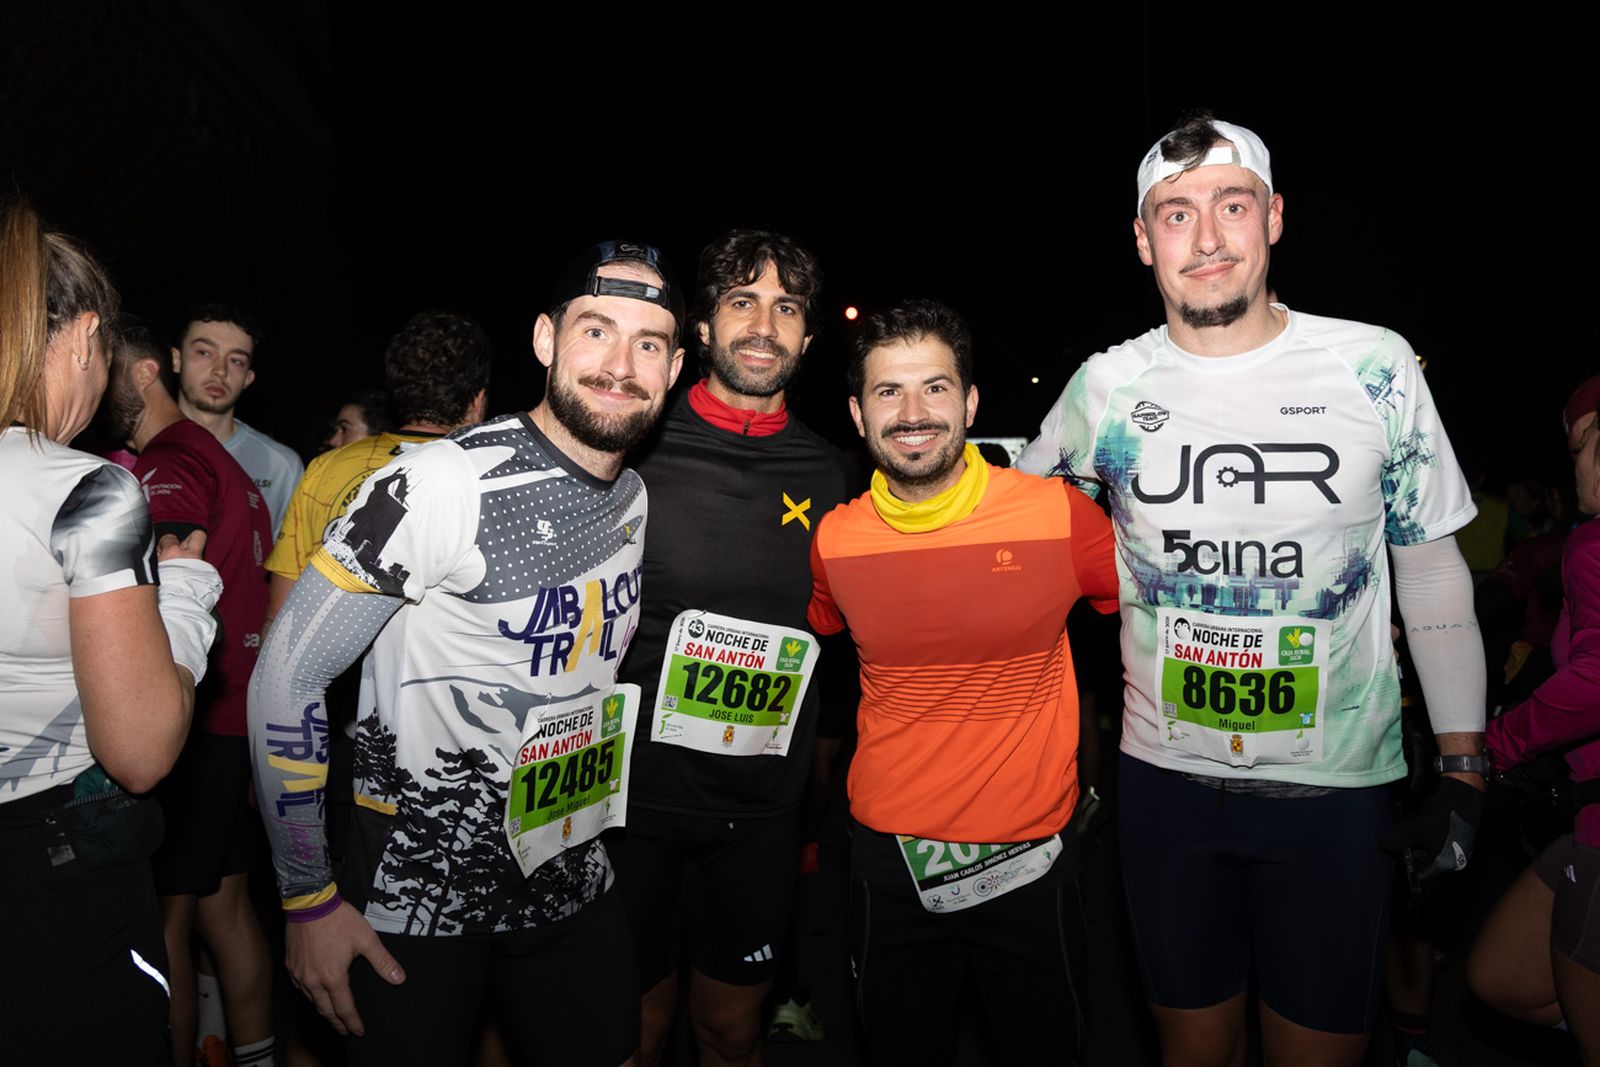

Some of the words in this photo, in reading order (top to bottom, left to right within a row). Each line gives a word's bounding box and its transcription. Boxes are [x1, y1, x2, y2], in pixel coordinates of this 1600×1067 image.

[1280, 406, 1327, 415] GSPORT
[1131, 443, 1342, 504] JAR
[705, 629, 749, 649] NOCHE
[751, 637, 769, 652] DE
[1192, 629, 1240, 648] NOCHE
[1243, 634, 1264, 648] DE
[684, 642, 715, 661] SAN
[717, 649, 766, 669] ANTÓN
[1174, 643, 1203, 662] SAN
[1206, 649, 1263, 668] ANTÓN
[682, 661, 792, 712] 12682
[1183, 665, 1296, 717] 8636
[538, 716, 580, 739] NOCHE
[580, 710, 594, 727] DE
[709, 709, 732, 721] JOSE
[735, 711, 754, 723] LUIS
[1218, 718, 1255, 732] Miguel
[520, 741, 548, 766] SAN
[551, 729, 593, 758] ANTÓN
[521, 739, 616, 814] 12485
